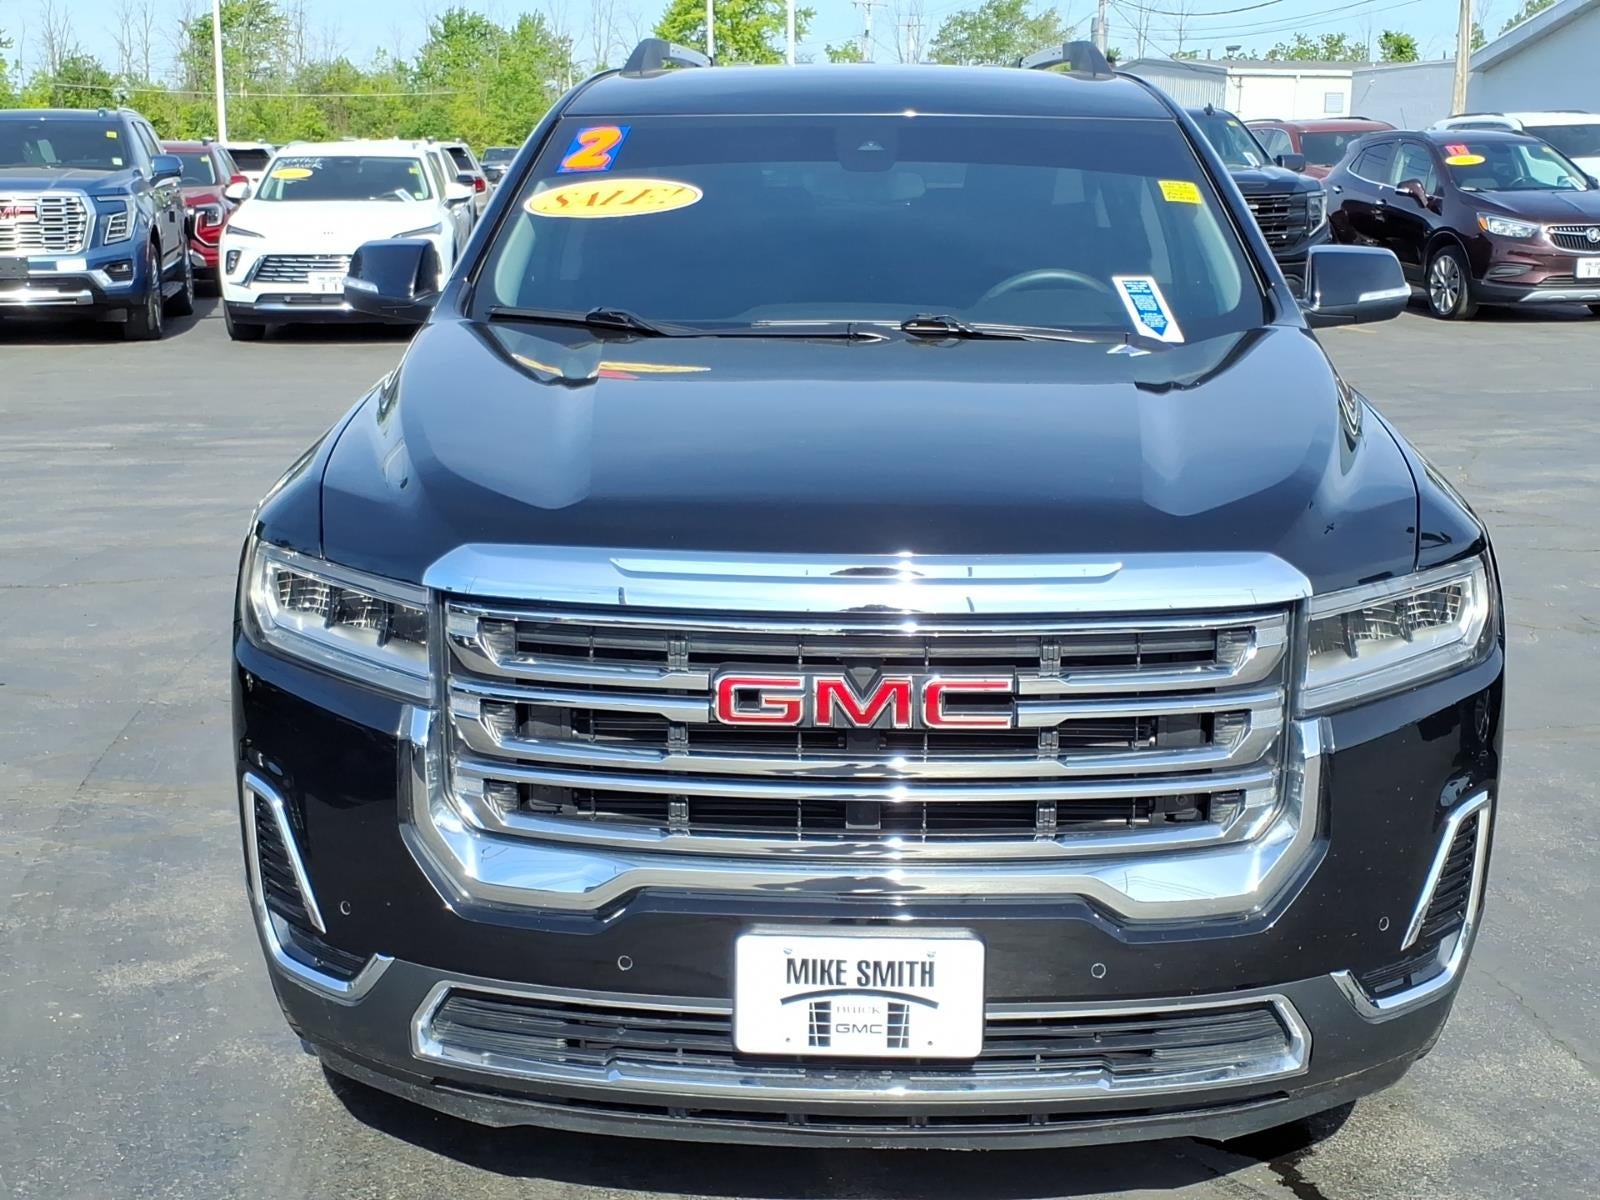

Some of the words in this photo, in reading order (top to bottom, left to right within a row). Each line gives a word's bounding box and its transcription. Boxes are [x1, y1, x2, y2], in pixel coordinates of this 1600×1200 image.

[562, 126, 622, 170] 2
[714, 675, 1013, 729] GMC
[786, 958, 848, 987] MIKE
[856, 959, 935, 988] SMITH
[835, 1023, 883, 1034] GMC
